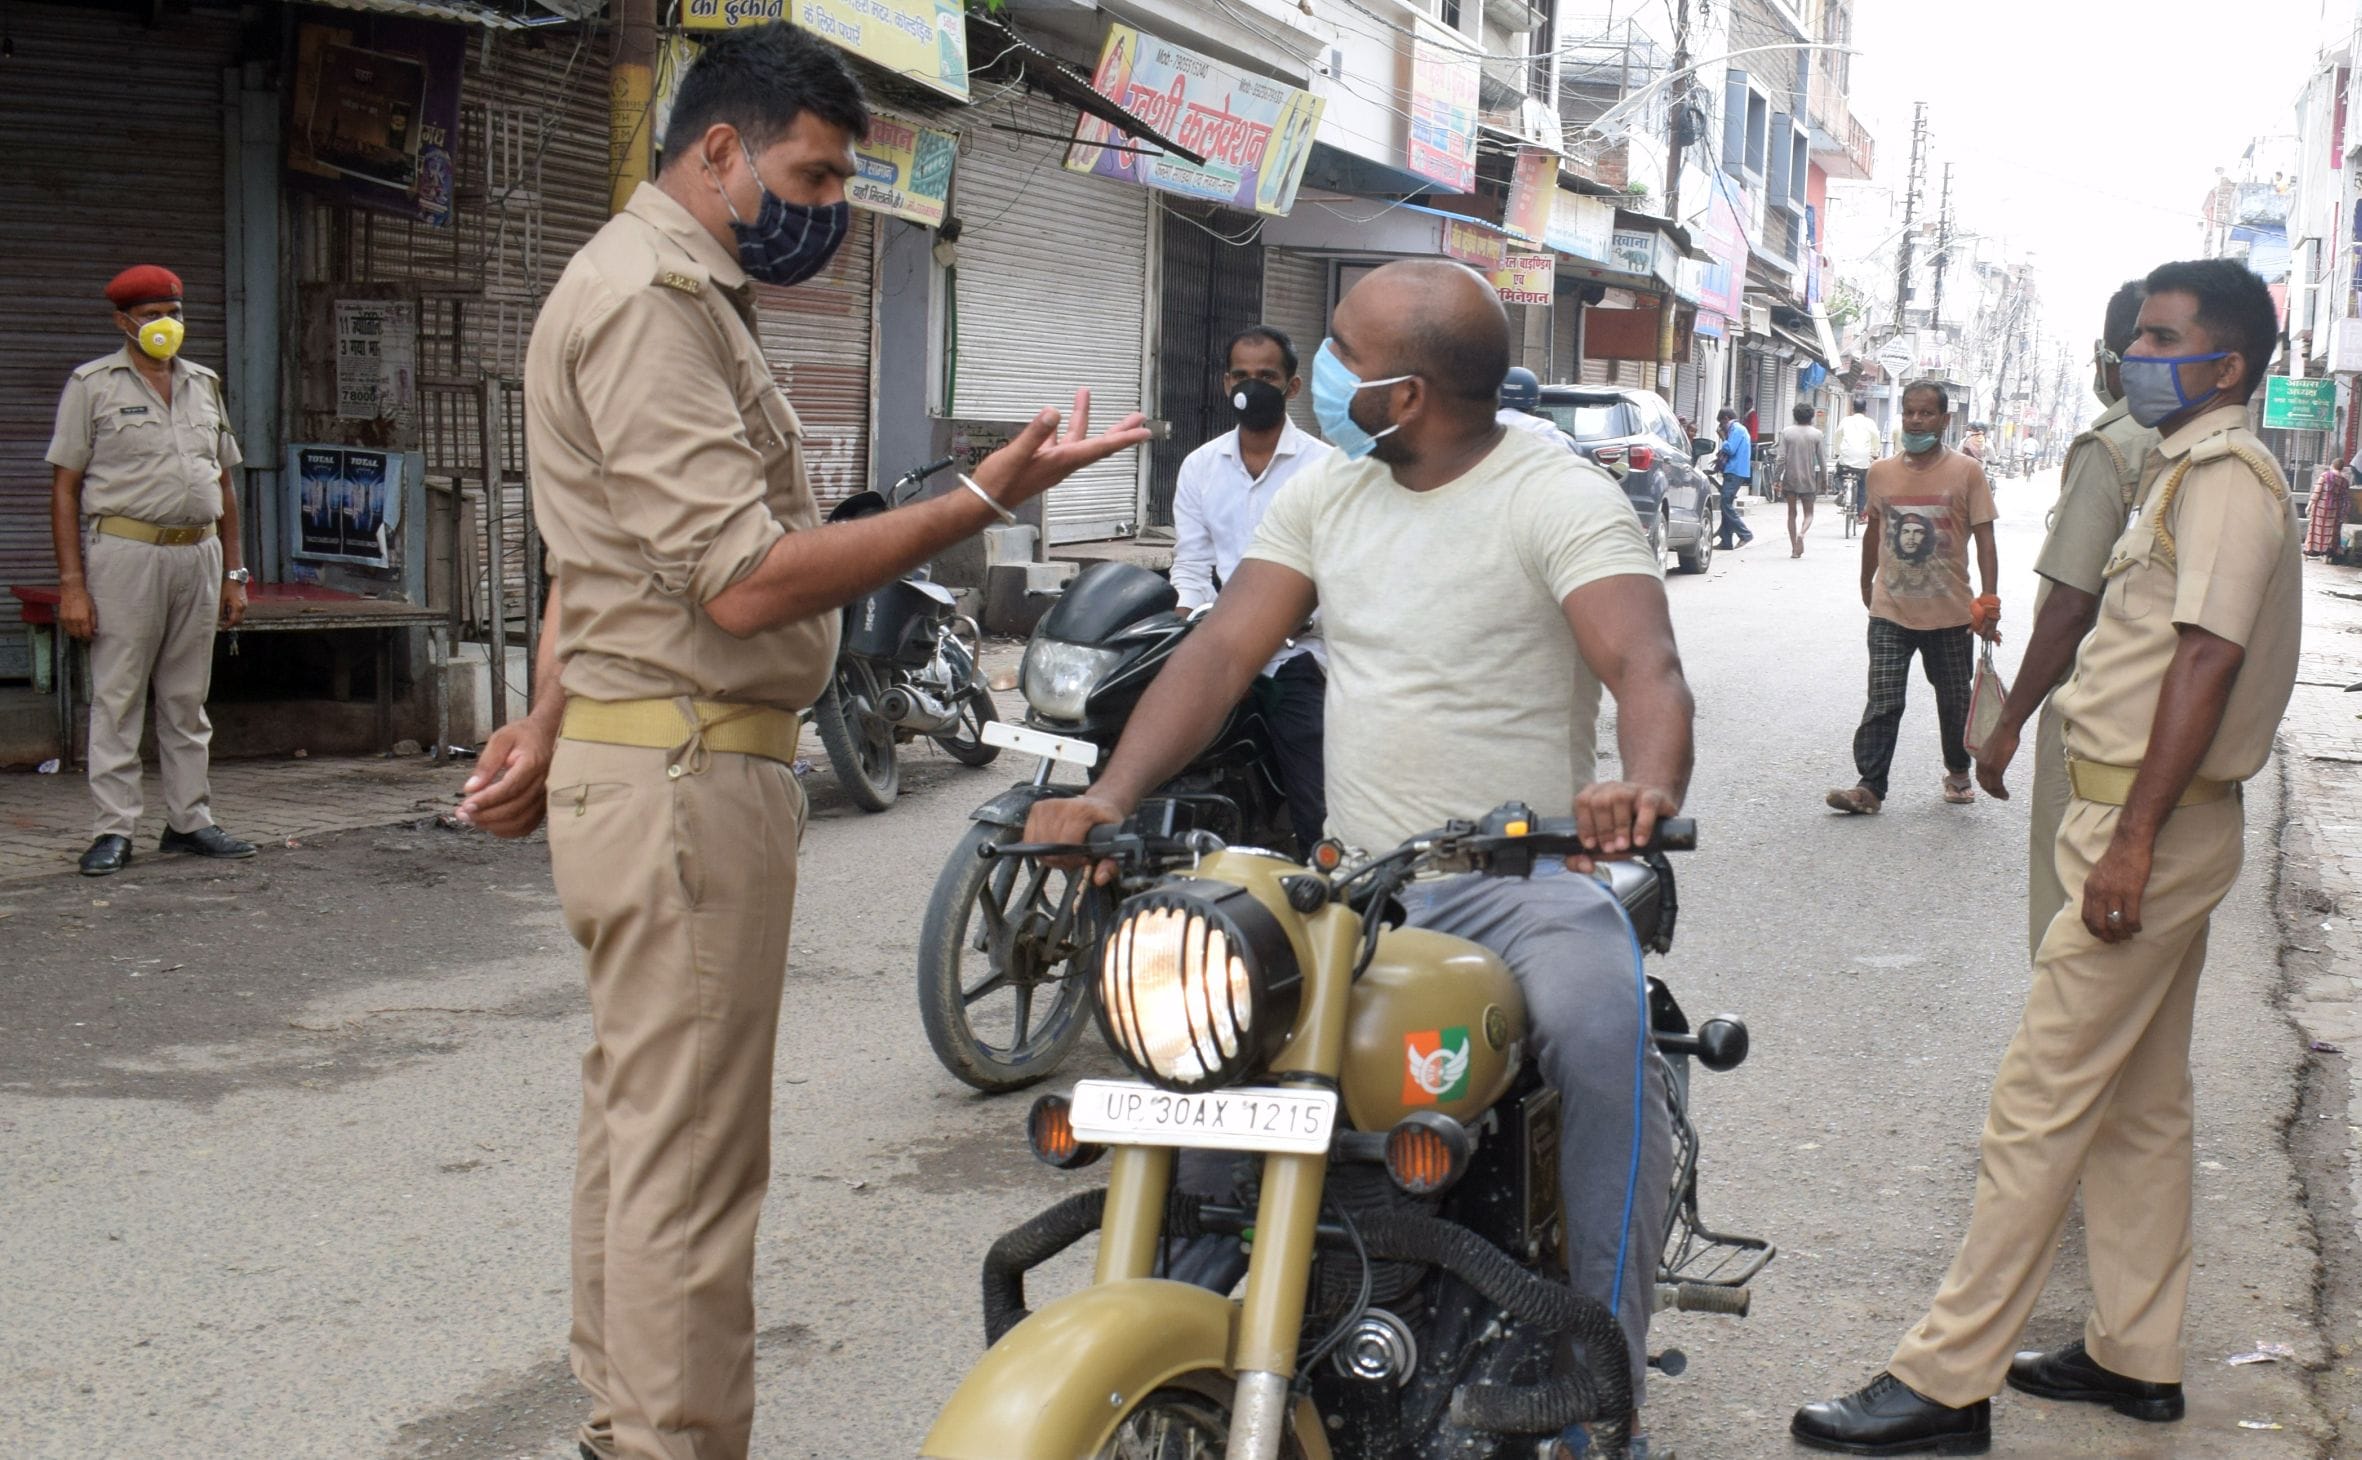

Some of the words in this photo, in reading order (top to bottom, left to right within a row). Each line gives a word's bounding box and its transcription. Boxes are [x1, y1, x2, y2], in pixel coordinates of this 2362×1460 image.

[1497, 287, 1550, 304] मिनेशन
[307, 455, 335, 464] TOTAL
[351, 457, 380, 467] TOTAL
[1106, 1092, 1142, 1121] UP
[1155, 1095, 1229, 1128] 30AX
[1248, 1100, 1323, 1134] 1215
